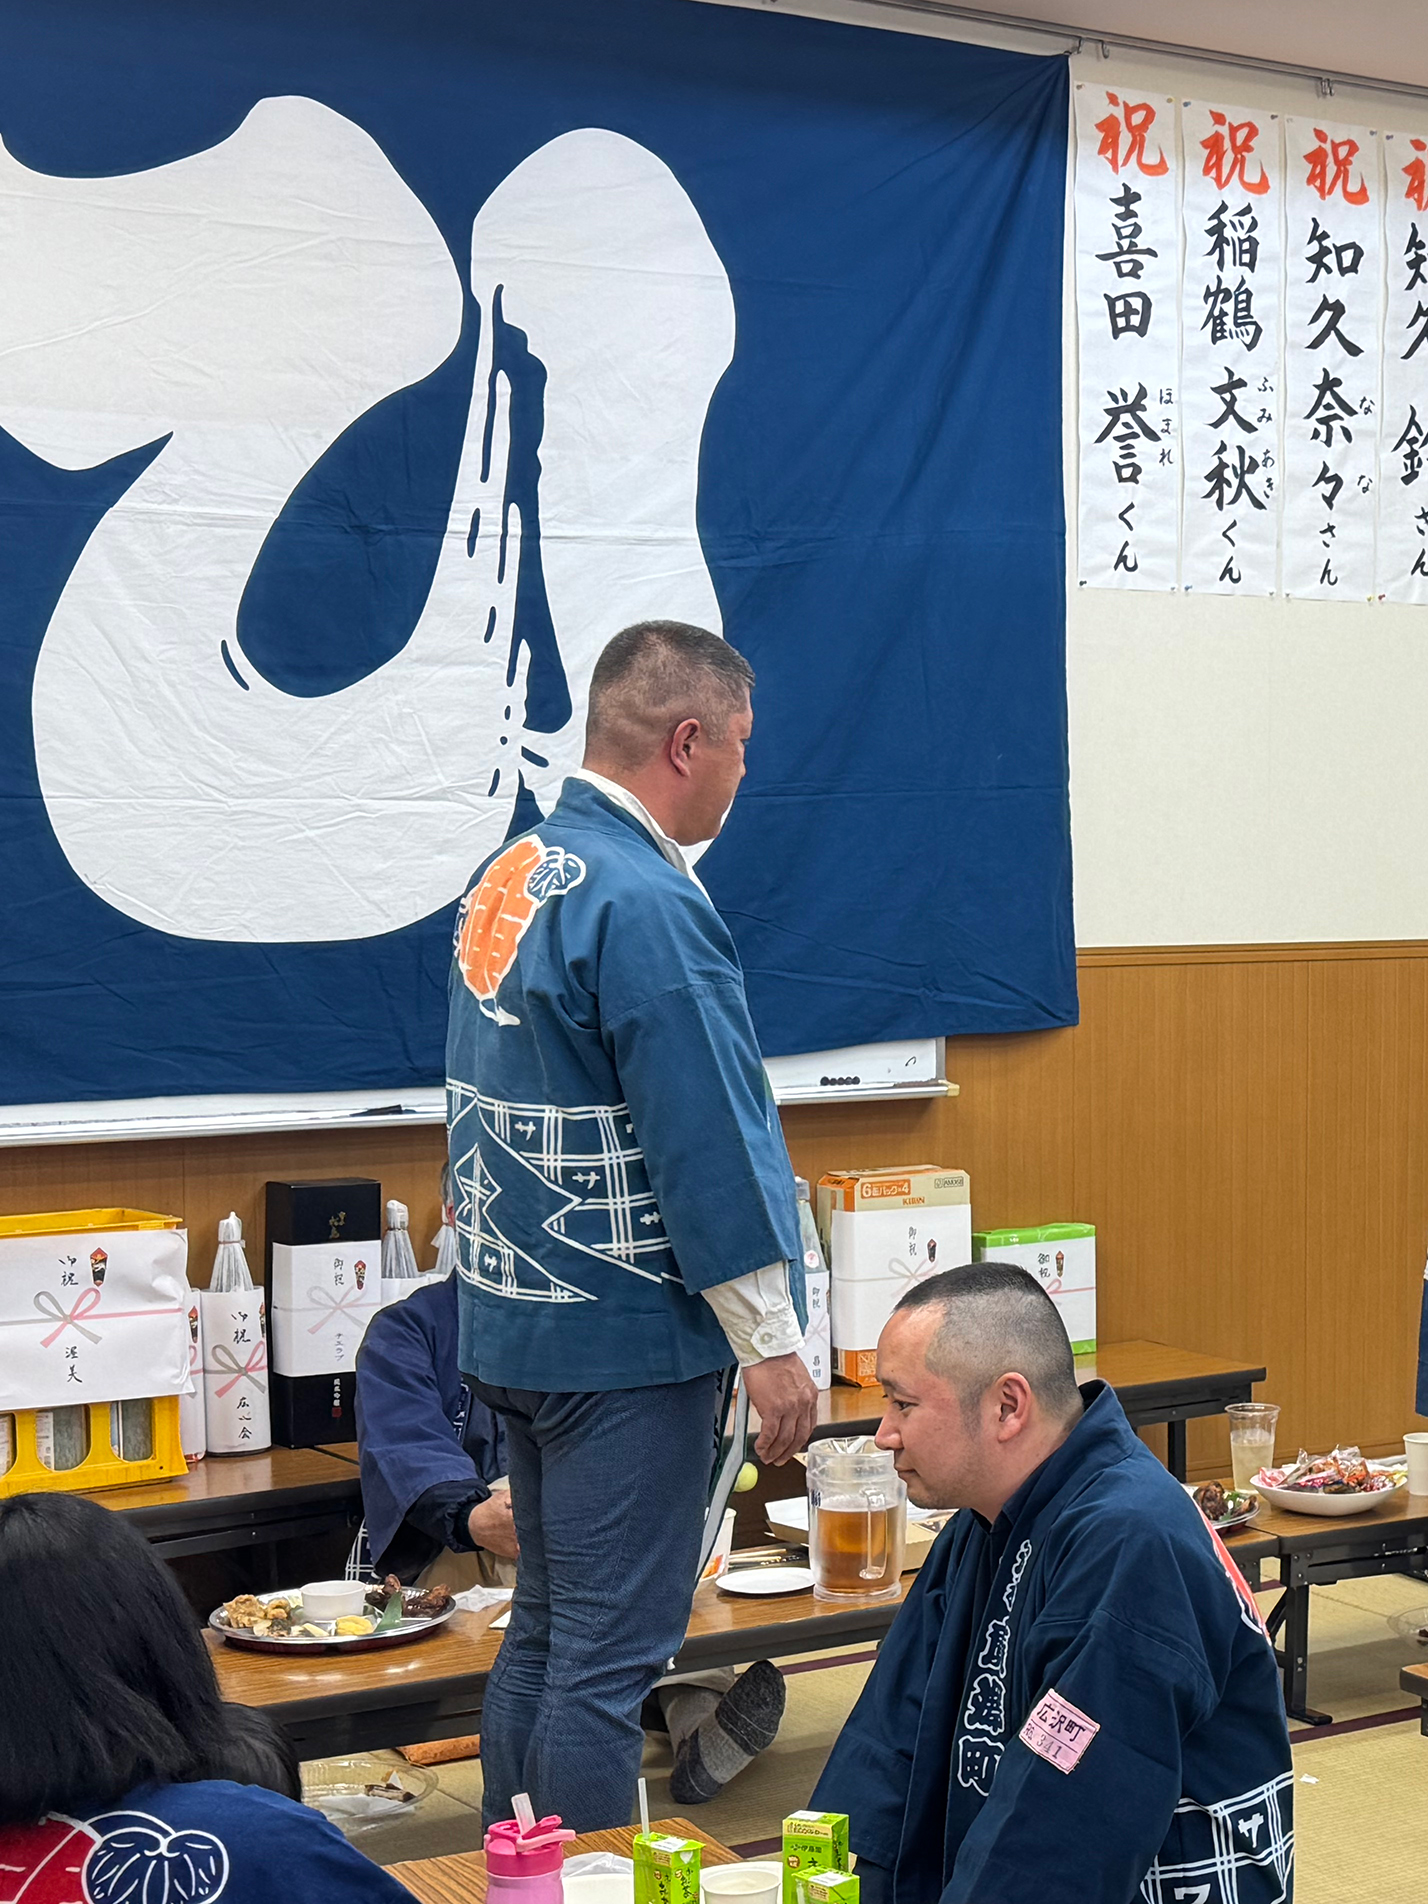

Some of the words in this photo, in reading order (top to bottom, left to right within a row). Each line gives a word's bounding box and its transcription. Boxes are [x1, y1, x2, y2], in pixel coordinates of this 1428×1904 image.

[1095, 92, 1169, 177] 祝
[1200, 109, 1270, 195] 祝
[1303, 128, 1370, 205] 祝
[1095, 182, 1158, 340] 喜田
[1159, 387, 1176, 466] ほまれ
[1094, 382, 1161, 573] 誉くん
[903, 1196, 925, 1206] KIRIN
[1036, 1733, 1063, 1760] 341
[1037, 1703, 1086, 1743] 広沢町
